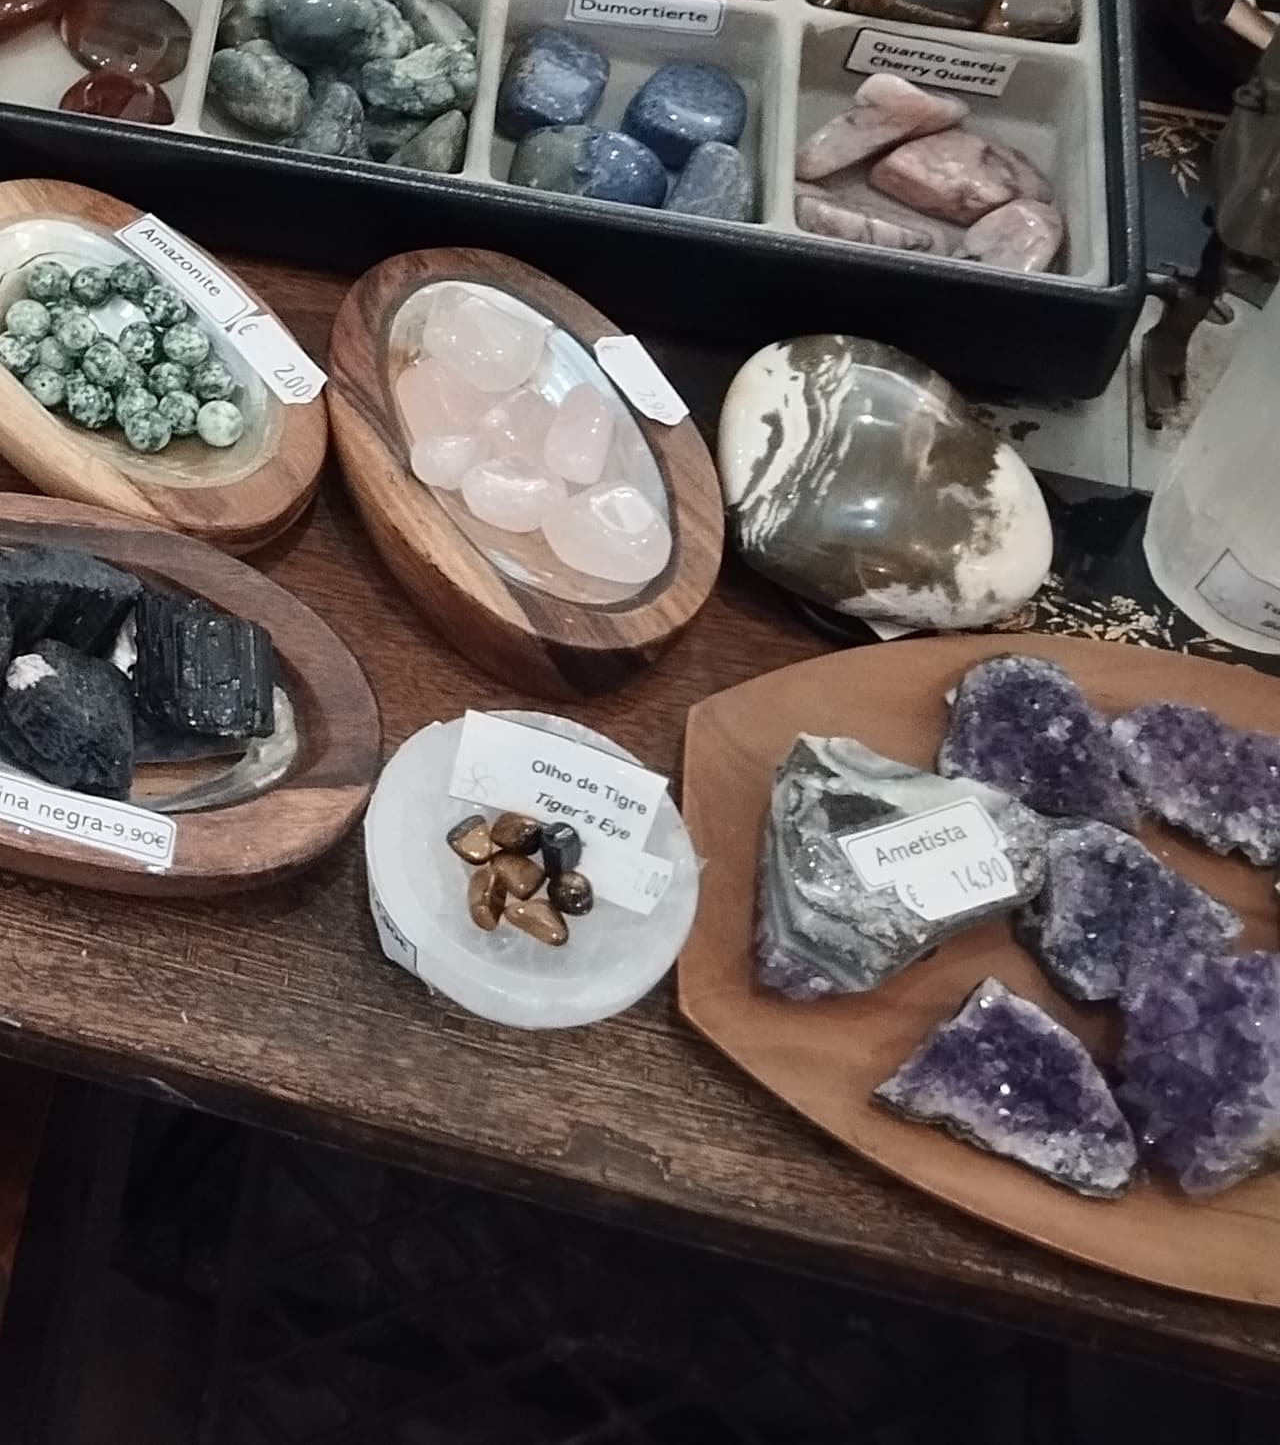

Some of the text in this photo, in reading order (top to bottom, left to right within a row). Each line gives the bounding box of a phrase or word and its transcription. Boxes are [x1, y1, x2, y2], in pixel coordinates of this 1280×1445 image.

[869, 55, 999, 87] Cherry Quartz
[873, 40, 1008, 76] Quartzo cereja
[138, 227, 222, 298] Amazonite
[531, 759, 648, 816] Olho de Tigre
[534, 791, 631, 840] Tiger's Eye
[875, 824, 968, 867] Ametista
